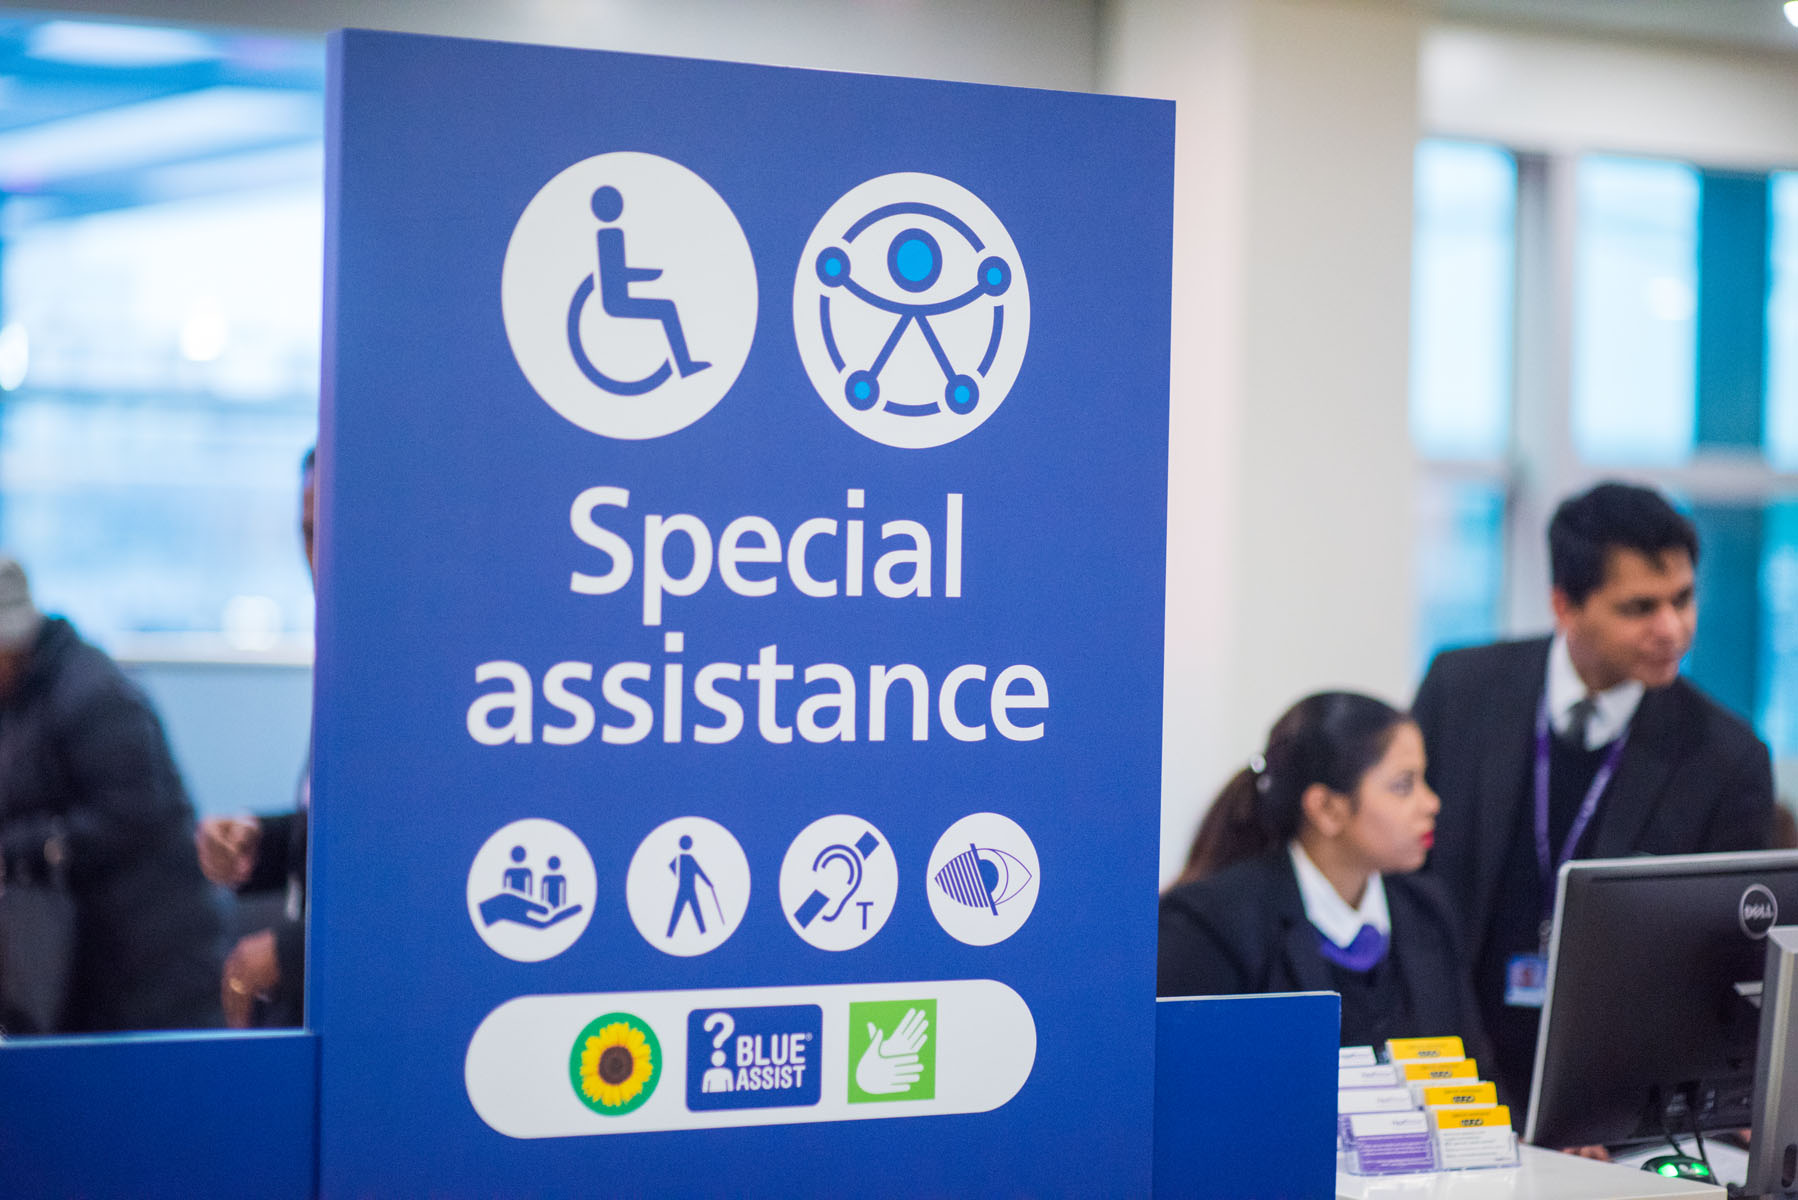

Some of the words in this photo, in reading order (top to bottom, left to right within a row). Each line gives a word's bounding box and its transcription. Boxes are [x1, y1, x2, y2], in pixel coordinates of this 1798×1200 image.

[569, 485, 964, 626] Special
[466, 631, 1050, 746] assistance
[856, 901, 874, 930] T
[735, 1064, 806, 1091] ASSIST
